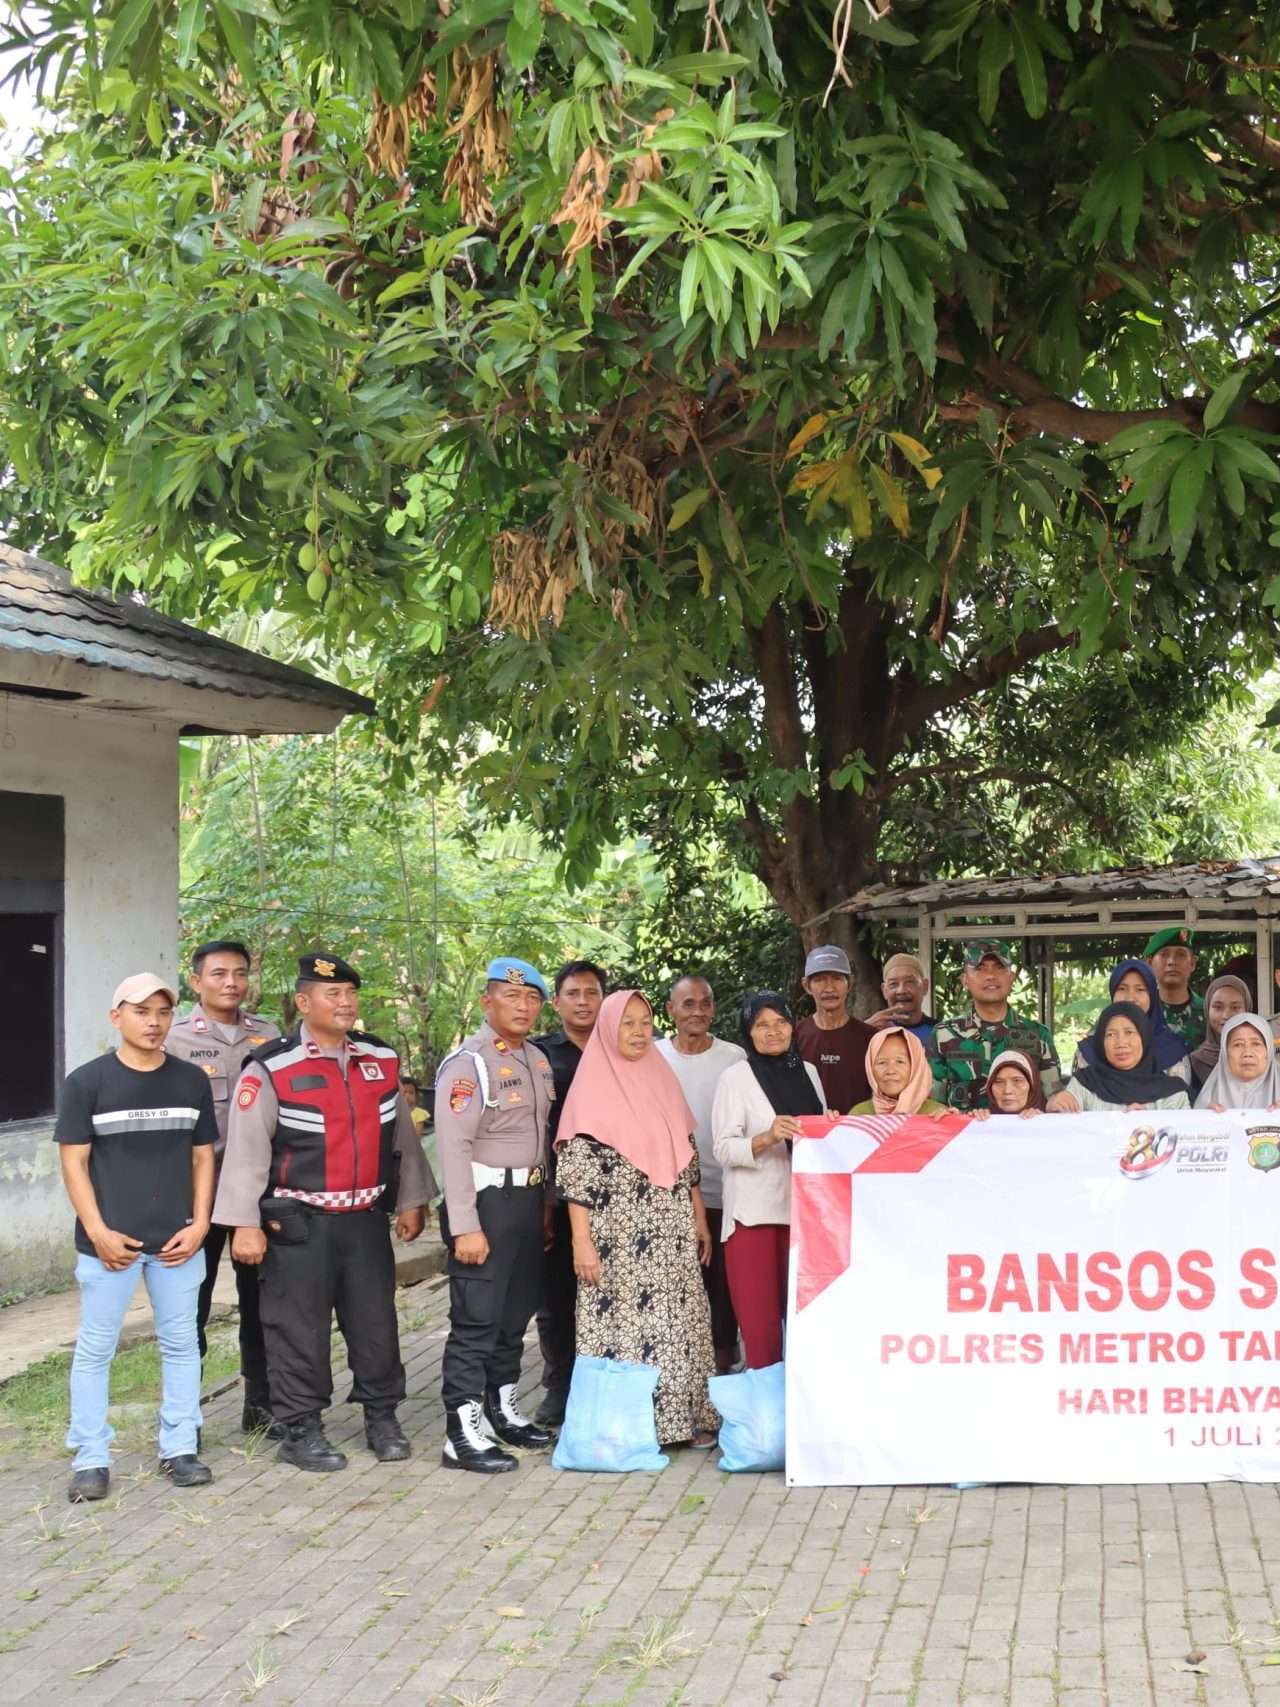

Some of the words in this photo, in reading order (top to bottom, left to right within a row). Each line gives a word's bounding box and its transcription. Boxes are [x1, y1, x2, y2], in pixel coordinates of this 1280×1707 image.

[946, 1249, 1217, 1314] BANSOS
[880, 1333, 1045, 1365] POLRES
[1059, 1331, 1206, 1365] METRO
[1057, 1387, 1149, 1415] HARI
[1164, 1427, 1176, 1447] 1
[1191, 1425, 1262, 1447] JULI
